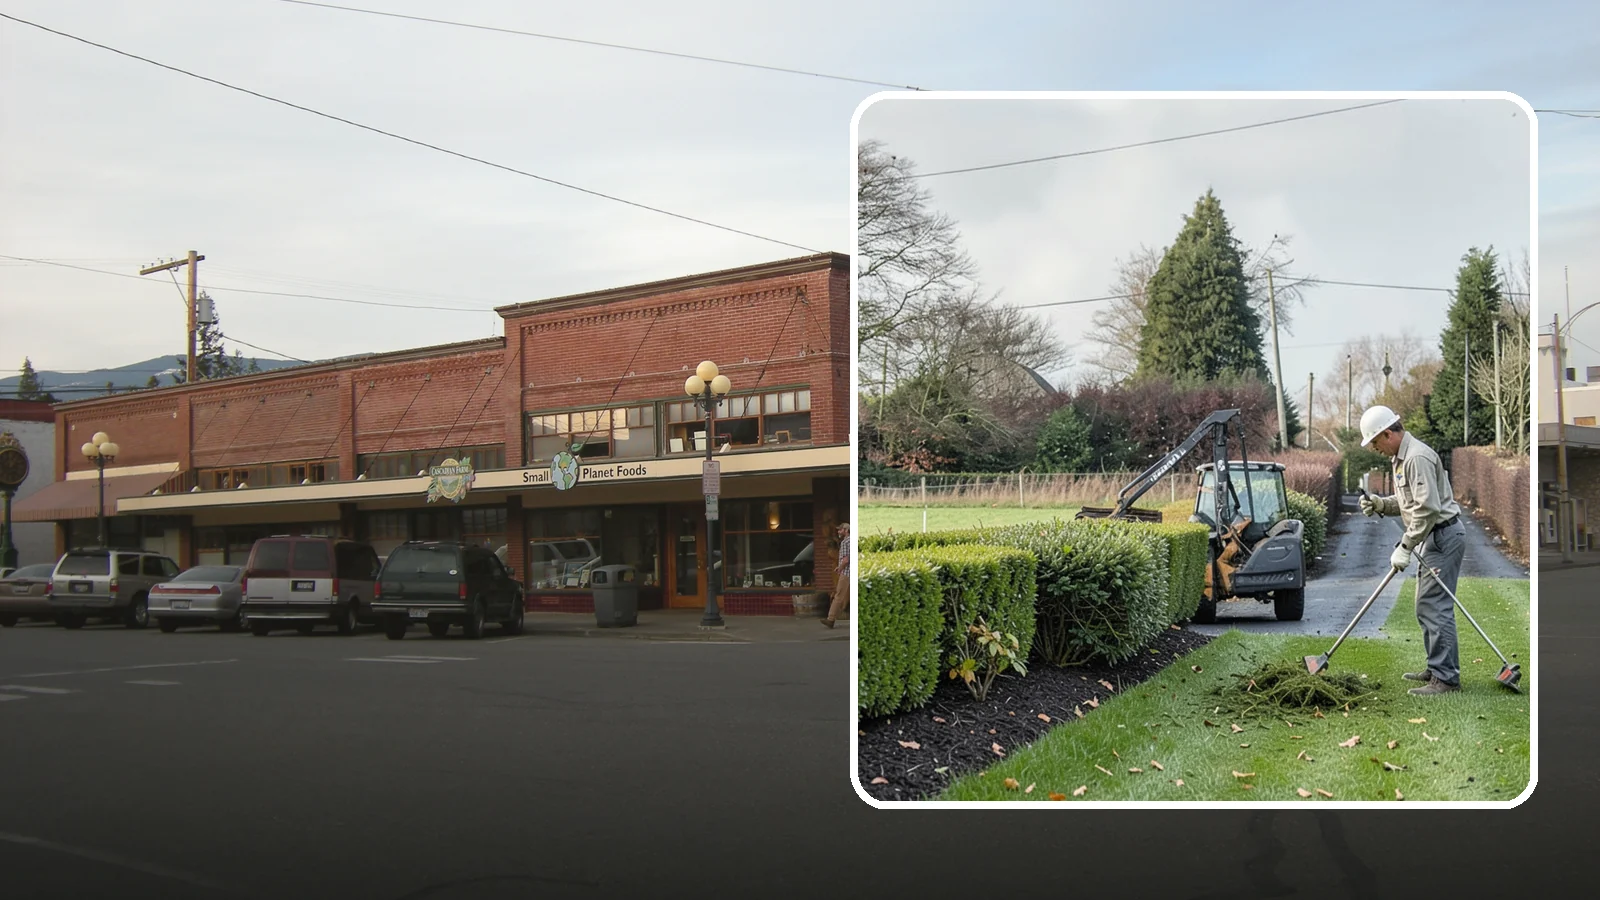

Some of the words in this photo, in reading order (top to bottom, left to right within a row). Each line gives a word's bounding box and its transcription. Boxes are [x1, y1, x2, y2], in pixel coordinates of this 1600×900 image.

[523, 470, 549, 483] Small
[583, 467, 614, 480] Planet
[617, 464, 647, 477] Foods
